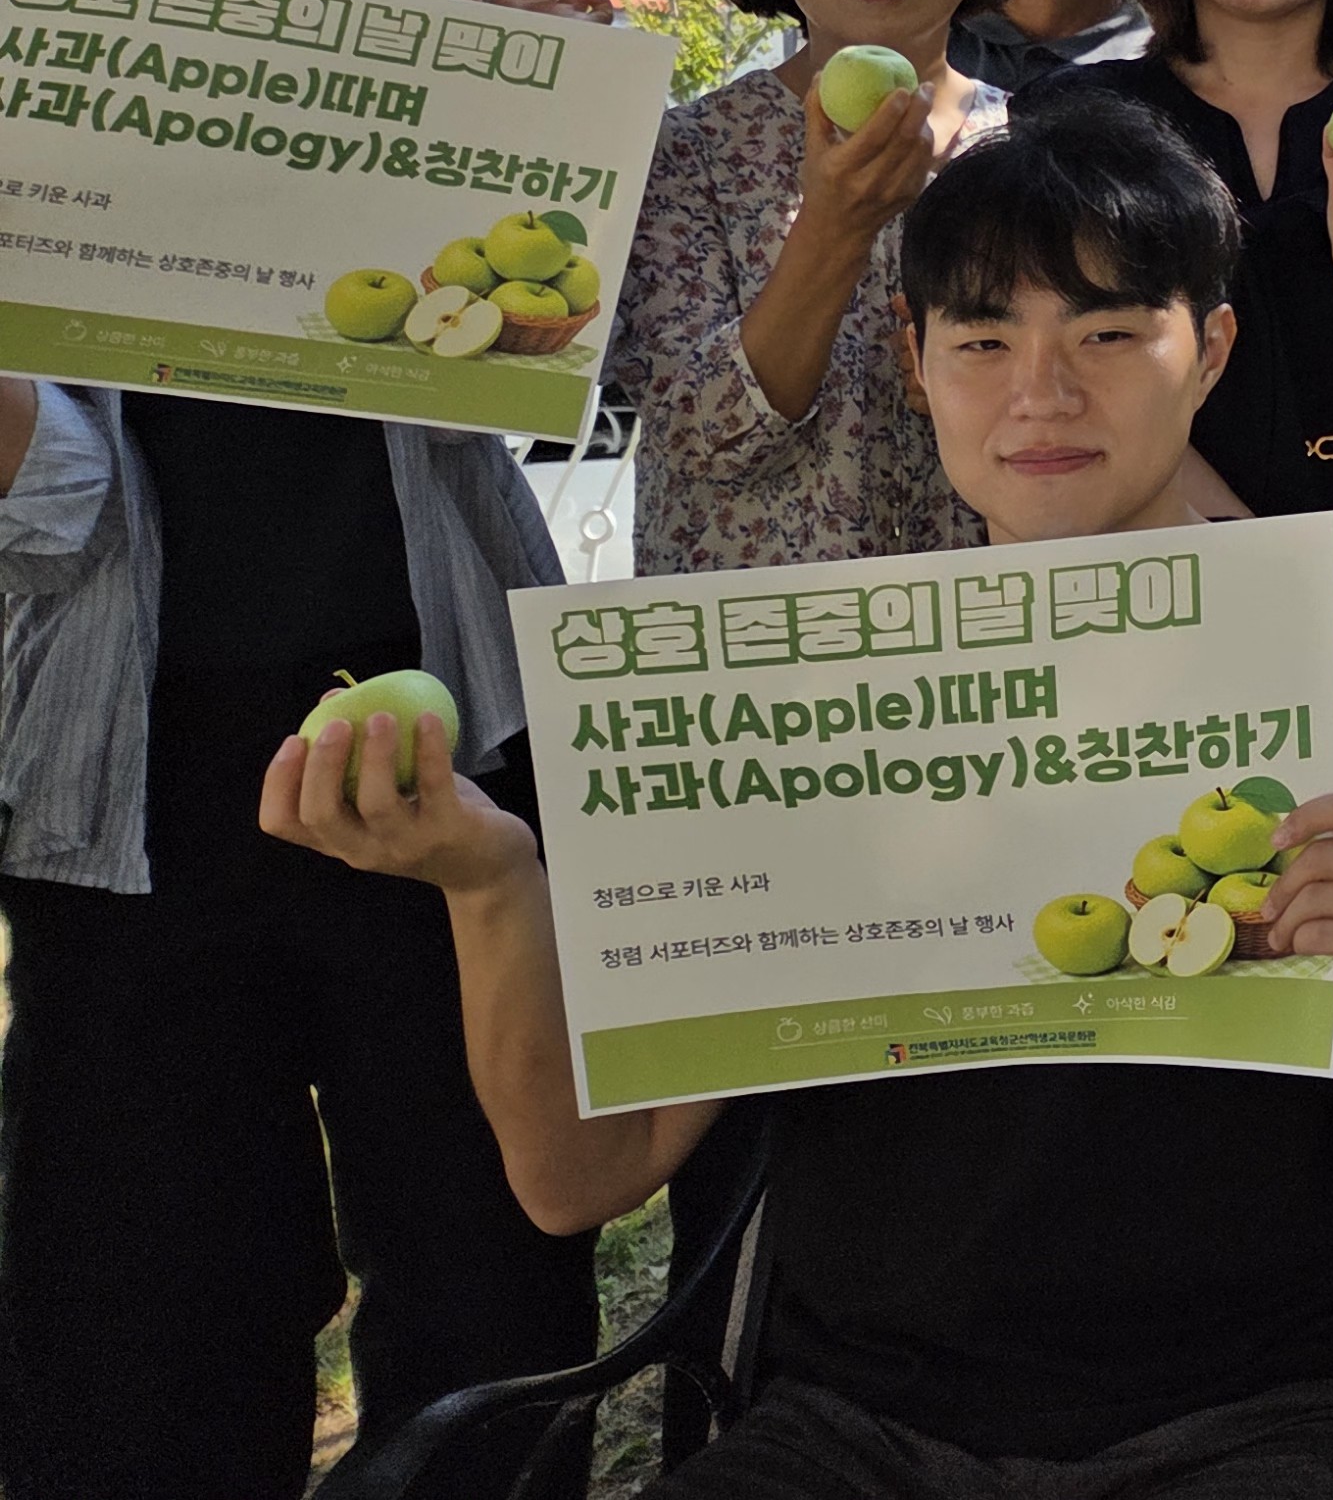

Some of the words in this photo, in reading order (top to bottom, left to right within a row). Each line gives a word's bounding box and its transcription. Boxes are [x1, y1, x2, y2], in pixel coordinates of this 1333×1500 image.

[0, 26, 428, 126] 사과(Apple)따며
[353, 2, 431, 66] 날
[432, 17, 565, 90] 맞이
[27, 183, 69, 205] 키운
[72, 189, 112, 211] 사과
[79, 242, 154, 269] 함께하는
[158, 253, 251, 282] 상호존중의
[256, 266, 275, 285] 날
[279, 269, 316, 290] 행사
[551, 601, 709, 680] 상호
[718, 580, 943, 669] 존중의
[954, 571, 1035, 650] 날
[1049, 553, 1202, 641] 맞이
[571, 664, 1059, 752] 사과(Apple)따며
[580, 704, 1312, 817] 사과(Apology)&칭찬하기
[592, 881, 678, 909] 청렴으로
[682, 876, 724, 899] 키운
[730, 872, 770, 894] 사과
[600, 945, 643, 969] 청렴
[649, 933, 752, 963] 서포터즈와
[758, 925, 840, 952] 함께하는
[845, 917, 945, 942] 상호존중의
[949, 916, 969, 937] 날
[974, 913, 1015, 935] 행사
